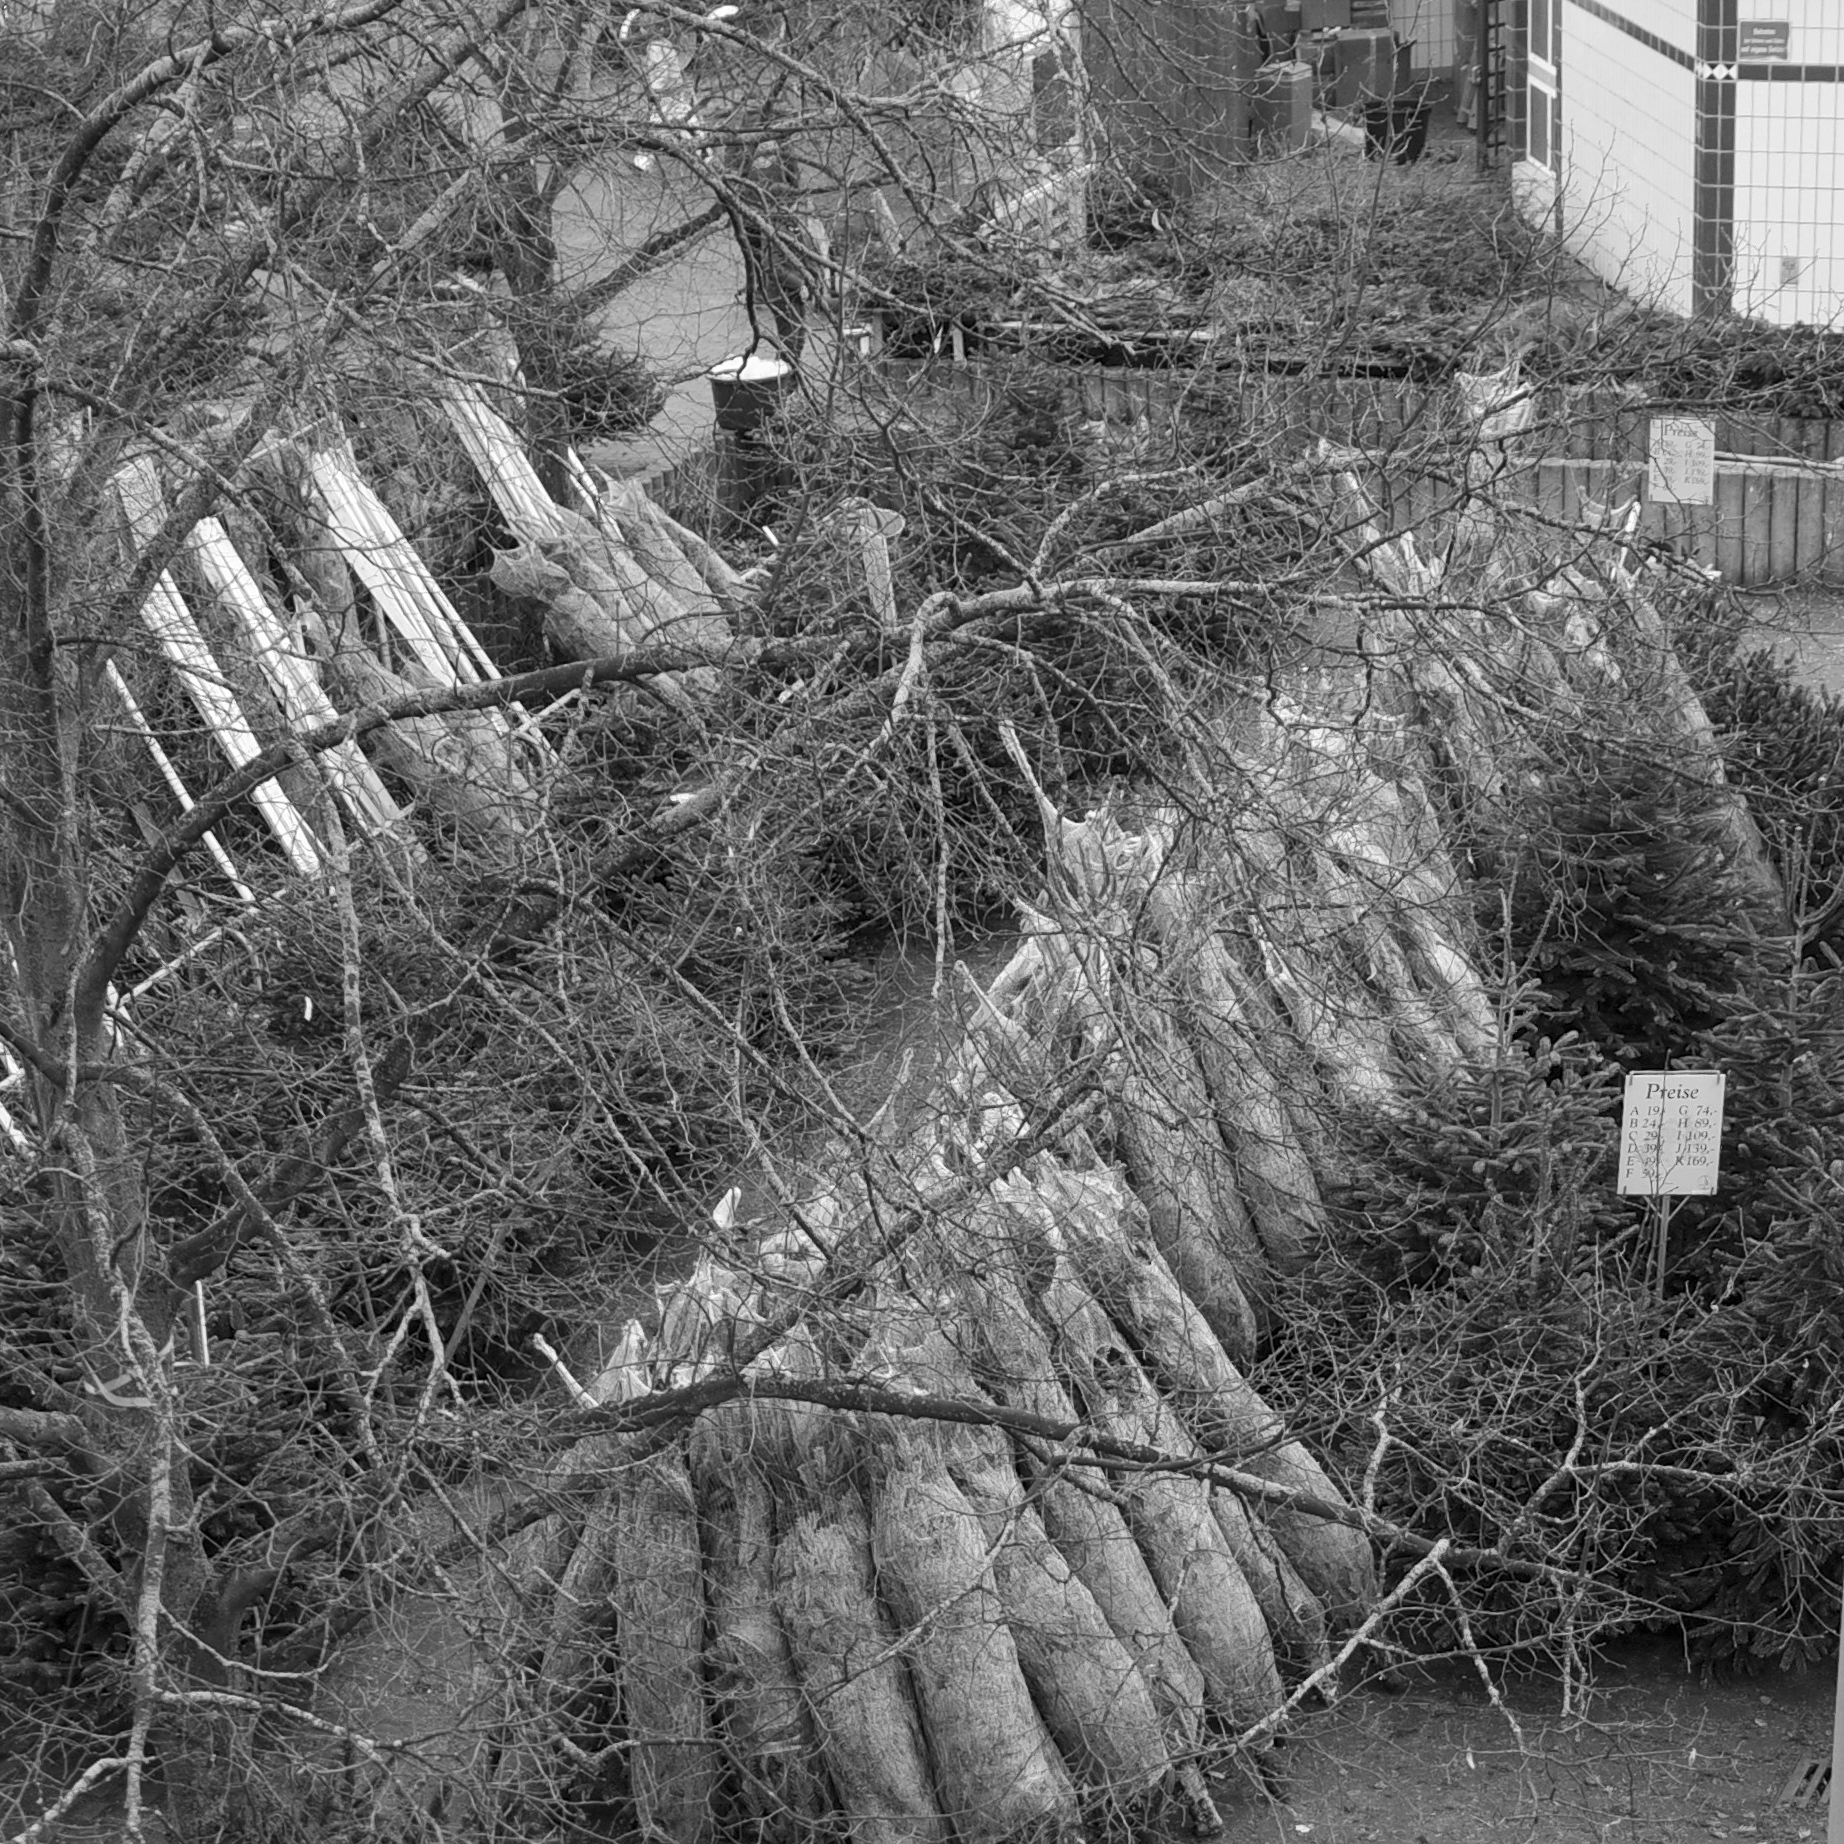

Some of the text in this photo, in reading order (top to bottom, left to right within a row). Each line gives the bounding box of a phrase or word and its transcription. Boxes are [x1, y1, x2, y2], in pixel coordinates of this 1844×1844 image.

[1645, 1083, 1699, 1099] Preise
[1630, 1106, 1639, 1116] A
[1678, 1105, 1717, 1117] G 74,-
[1629, 1118, 1638, 1128] B
[1678, 1118, 1716, 1129] H 89,-
[1628, 1130, 1638, 1141] C
[1627, 1143, 1638, 1153] D
[1626, 1156, 1637, 1166] E
[1675, 1156, 1685, 1166] K
[1626, 1168, 1635, 1178] F
